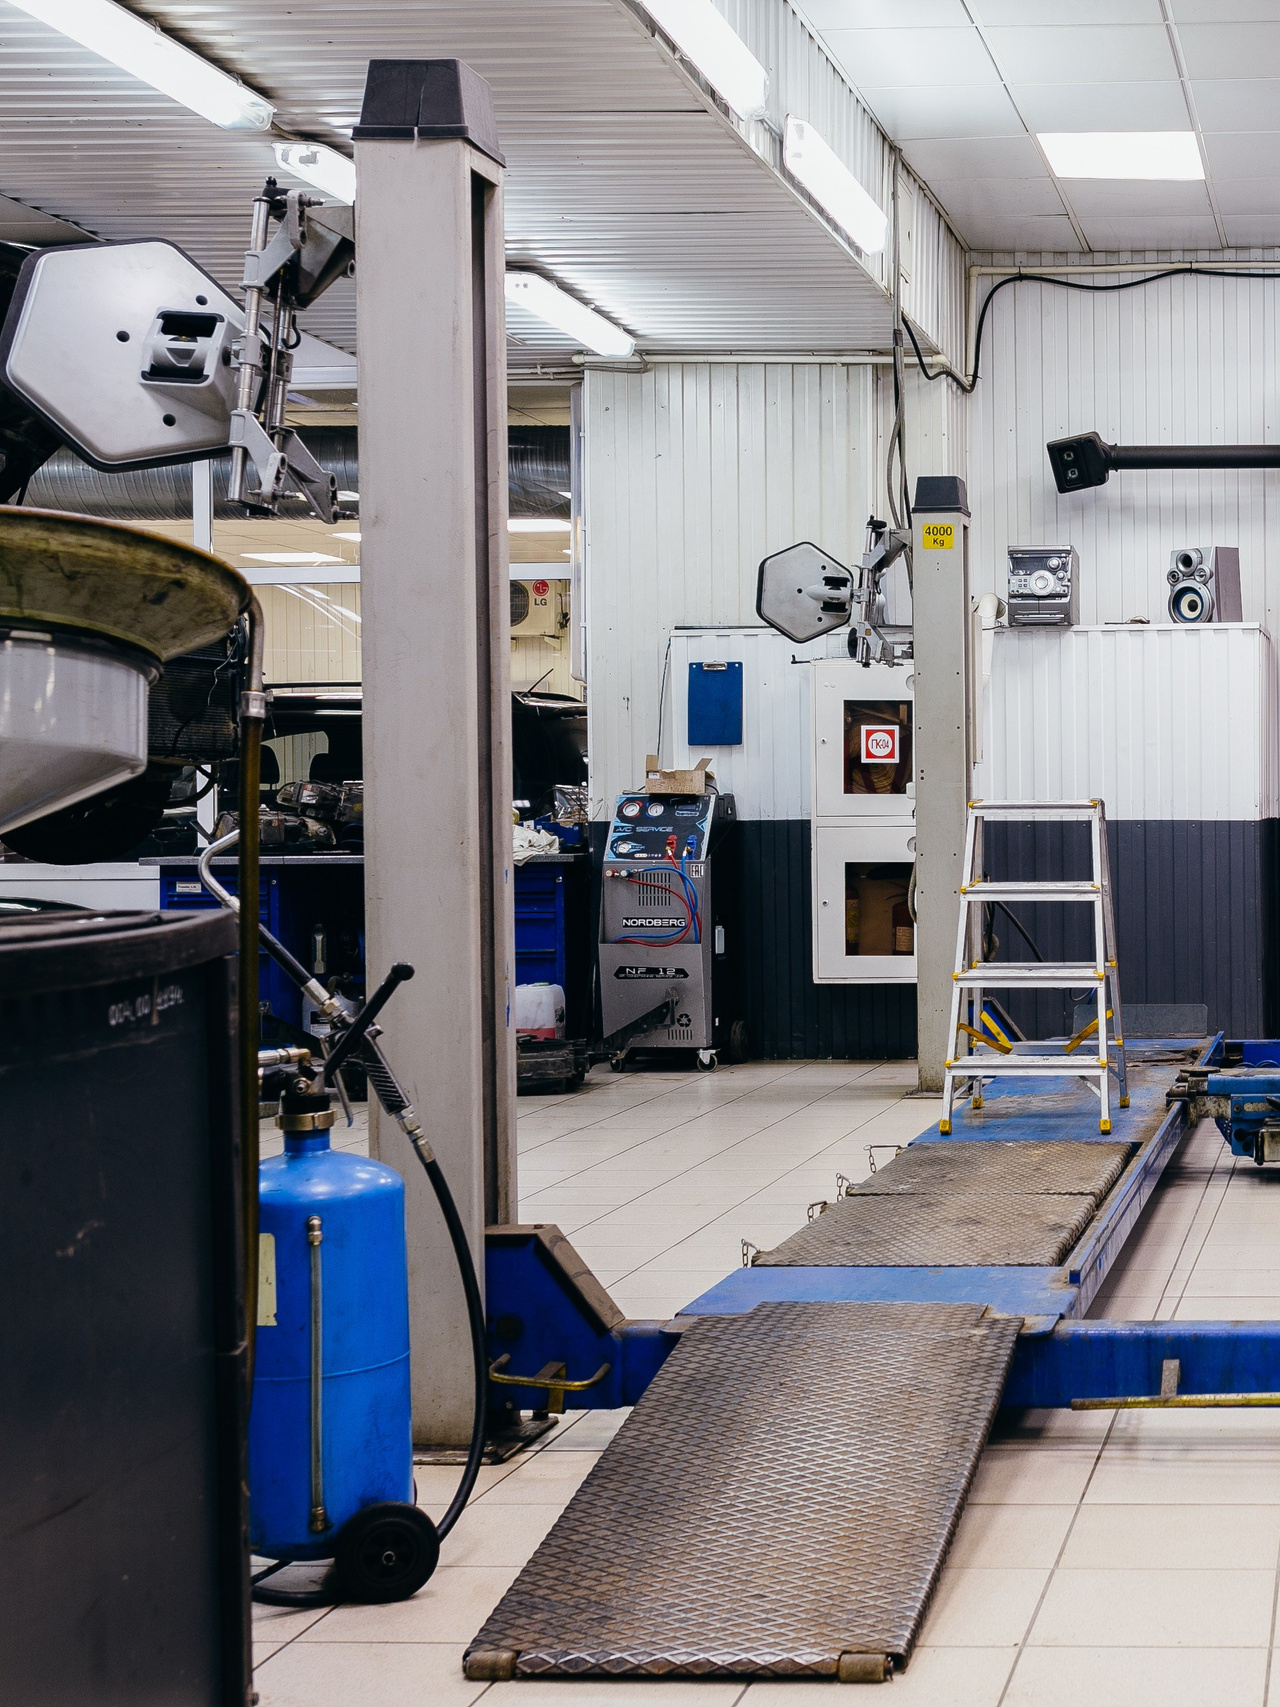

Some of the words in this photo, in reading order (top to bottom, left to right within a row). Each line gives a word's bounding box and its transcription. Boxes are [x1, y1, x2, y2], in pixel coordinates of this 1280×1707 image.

[924, 526, 953, 536] 4000
[932, 537, 945, 547] Kg
[534, 597, 548, 607] LG
[622, 918, 686, 927] NORDBERG
[658, 967, 676, 975] 12
